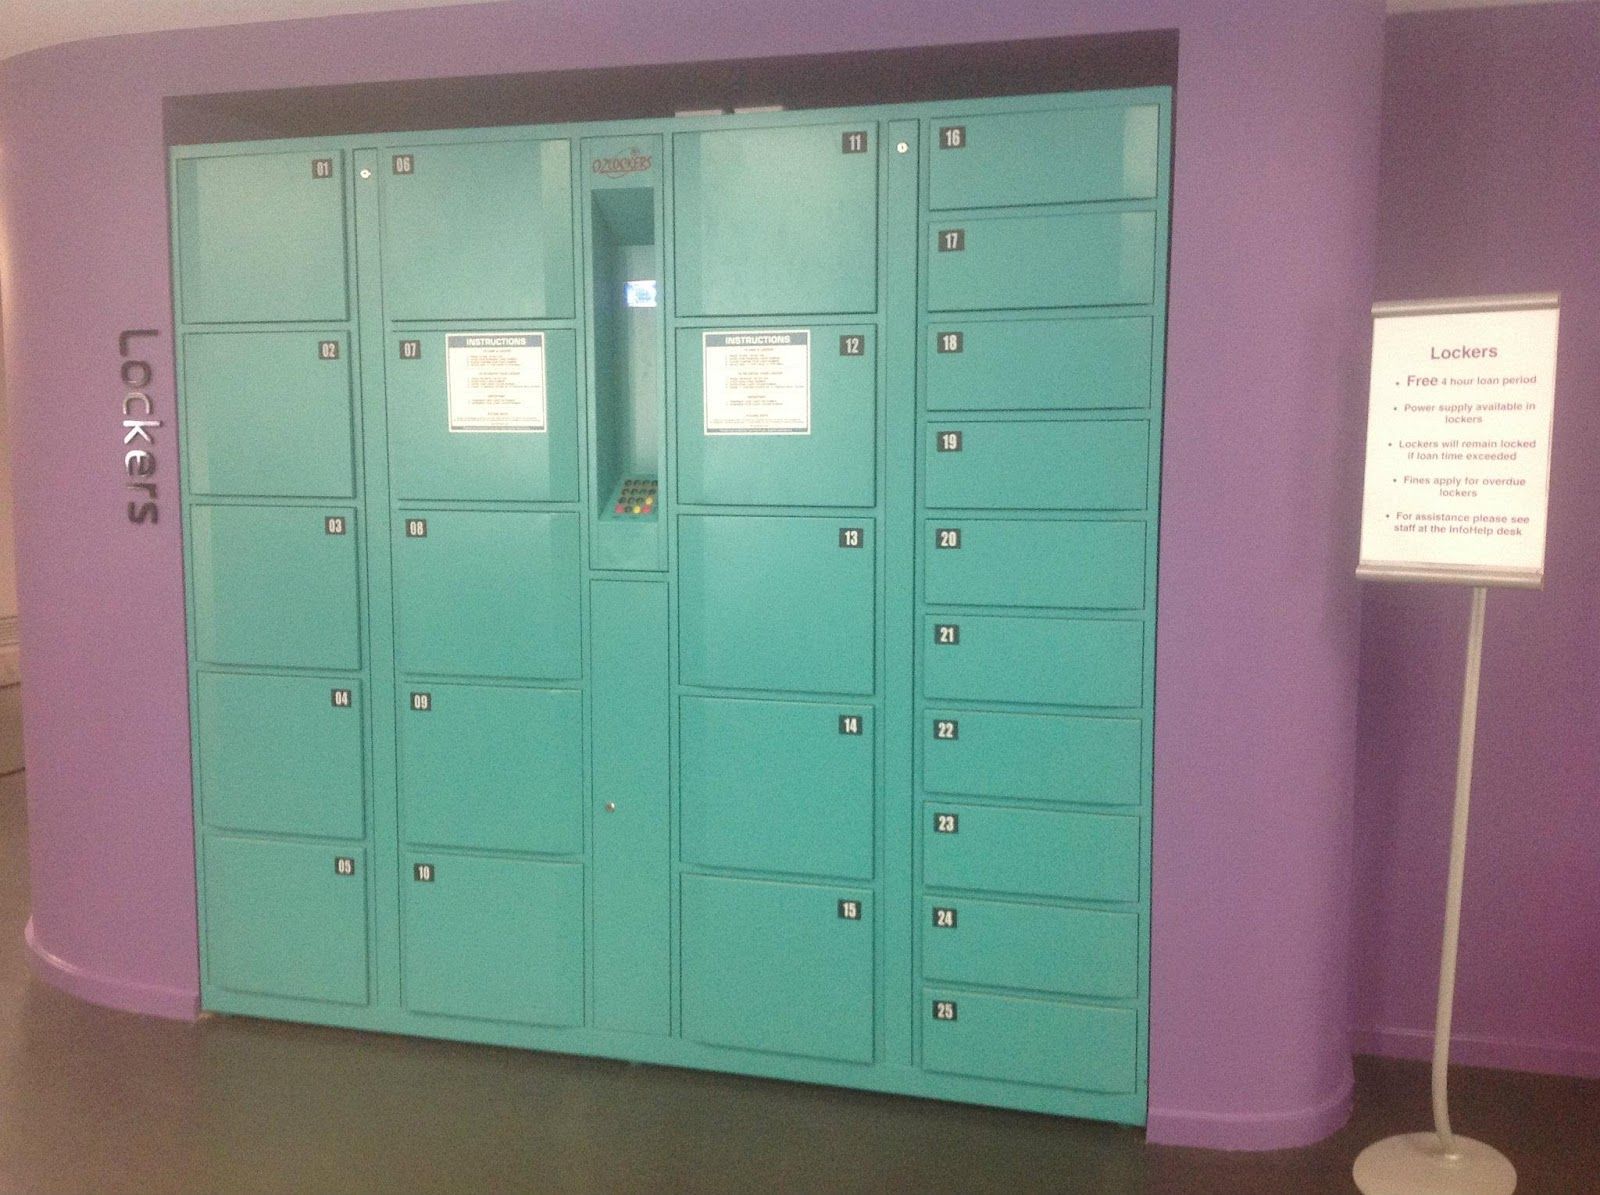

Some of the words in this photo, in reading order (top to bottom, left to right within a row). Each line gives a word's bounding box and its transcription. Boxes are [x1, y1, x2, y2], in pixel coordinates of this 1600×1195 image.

[849, 134, 862, 151] 11
[945, 129, 961, 147] 16
[316, 161, 329, 177] 01
[396, 156, 411, 173] 06
[945, 232, 958, 249] 17
[466, 337, 526, 346] INSTRUCTIONS
[725, 335, 791, 345] INSTRUCTIONS
[845, 337, 859, 354] 12
[942, 334, 958, 351] 18
[322, 342, 336, 358] 02
[404, 342, 417, 357] 07
[1431, 345, 1498, 360] Lockers
[1407, 375, 1438, 387] Free
[1450, 377, 1474, 385] hour
[1477, 376, 1499, 384] loan
[1502, 375, 1537, 386] period
[1404, 403, 1435, 412] Power
[1438, 403, 1473, 413] supply
[1475, 402, 1522, 411] available
[1526, 402, 1536, 410] in
[119, 329, 160, 524] Lockers
[1445, 415, 1482, 424] lockers
[942, 433, 958, 450] 19
[1399, 440, 1439, 448] Lockers
[1442, 440, 1458, 448] will
[1462, 440, 1497, 448] remain
[1500, 440, 1536, 448] locked
[1408, 452, 1414, 460] if
[1417, 452, 1438, 460] loan
[1441, 452, 1463, 460] time
[1466, 452, 1517, 460] exceeded
[1403, 476, 1430, 484] Fines
[1433, 476, 1462, 486] apply
[1465, 477, 1479, 485] for
[1482, 477, 1526, 486] overdue
[1440, 488, 1477, 497] lockers
[328, 518, 343, 533] 03
[1396, 512, 1412, 520] For
[1416, 512, 1469, 521] assistance
[1473, 514, 1508, 524] please
[1511, 516, 1530, 524] see
[409, 521, 424, 536] 08
[1394, 524, 1416, 532] staff
[1430, 525, 1446, 533] the
[1496, 527, 1522, 536] desk
[844, 530, 858, 546] 13
[940, 531, 957, 547] 20
[940, 626, 954, 643] 21
[335, 691, 348, 706] 04
[414, 694, 428, 709] 09
[844, 718, 858, 733] 14
[938, 721, 954, 738] 22
[938, 815, 955, 832] 23
[338, 859, 352, 874] 05
[418, 865, 430, 881] 10
[843, 902, 857, 918] 15
[937, 910, 953, 926] 24
[937, 1002, 954, 1020] 25
